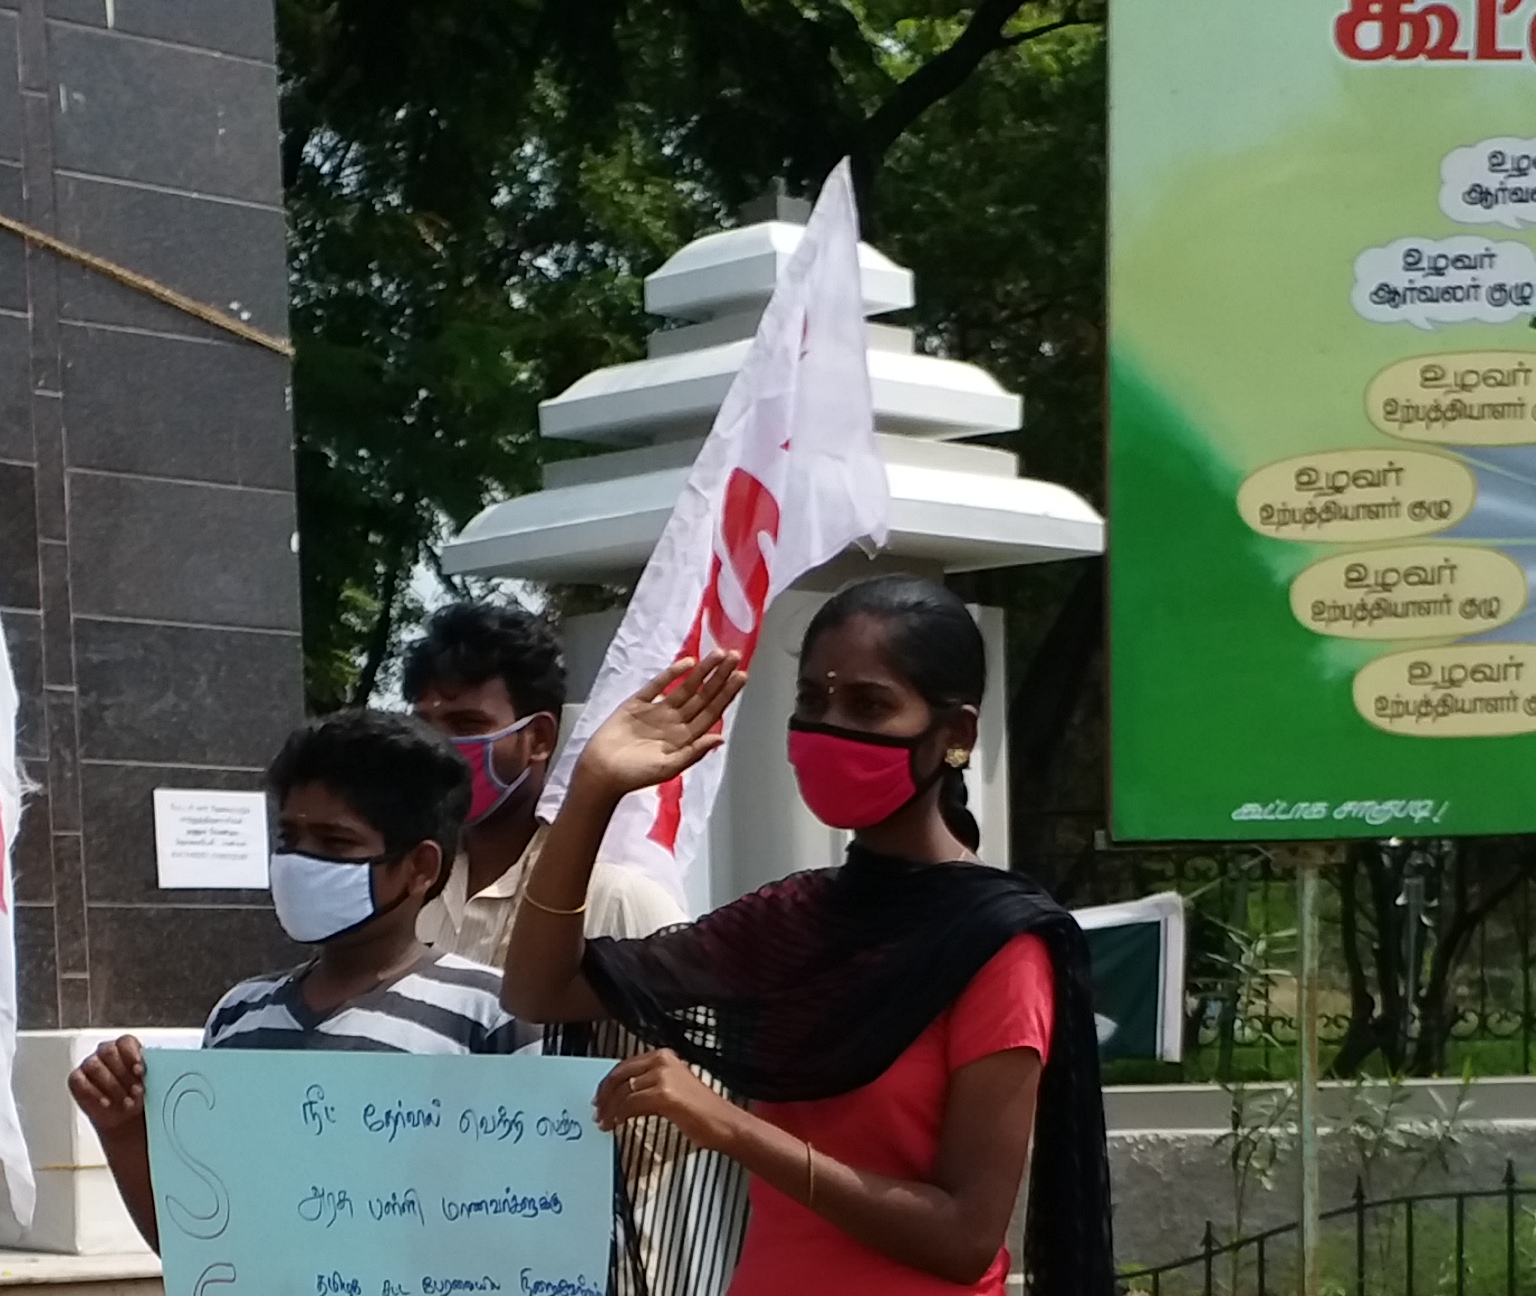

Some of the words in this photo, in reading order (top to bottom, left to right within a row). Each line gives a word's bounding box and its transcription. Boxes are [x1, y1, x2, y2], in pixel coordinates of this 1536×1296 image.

[1401, 246, 1498, 278] உழவர்
[1369, 276, 1481, 308] ஆர்வலர்
[1485, 279, 1535, 308] குழு
[1419, 361, 1534, 397] உழவர்
[1381, 396, 1526, 431] உற்பத்தியாளர்
[1293, 460, 1405, 498] உழவர்
[1258, 497, 1400, 530] உற்பத்தியாளர்
[1407, 499, 1452, 522] குழு
[1344, 559, 1459, 594] உழவர்
[1310, 593, 1452, 628] உற்பத்தியாளர்
[1458, 596, 1501, 621] குழு
[1407, 655, 1526, 691] உழவர்
[1373, 690, 1519, 726] உற்பத்தியாளர்
